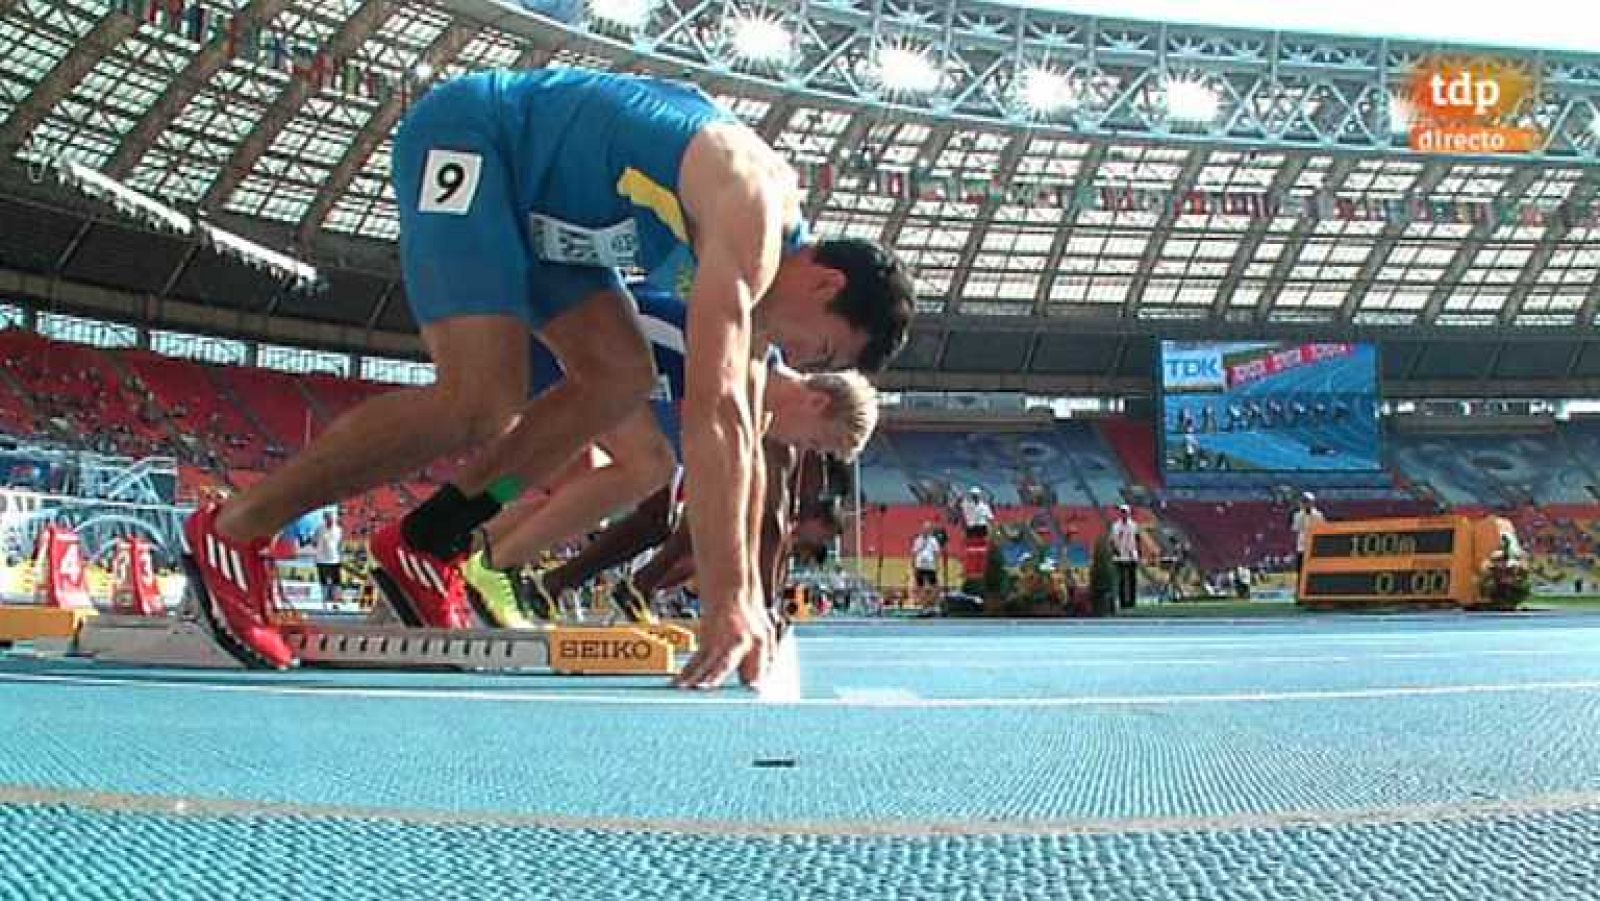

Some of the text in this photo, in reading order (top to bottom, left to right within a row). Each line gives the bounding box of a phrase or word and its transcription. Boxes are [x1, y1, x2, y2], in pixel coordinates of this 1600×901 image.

[435, 162, 465, 204] 9
[1166, 358, 1222, 378] TDK
[1352, 533, 1416, 556] 100m
[60, 543, 80, 583] 4
[559, 639, 651, 659] SEIKO
